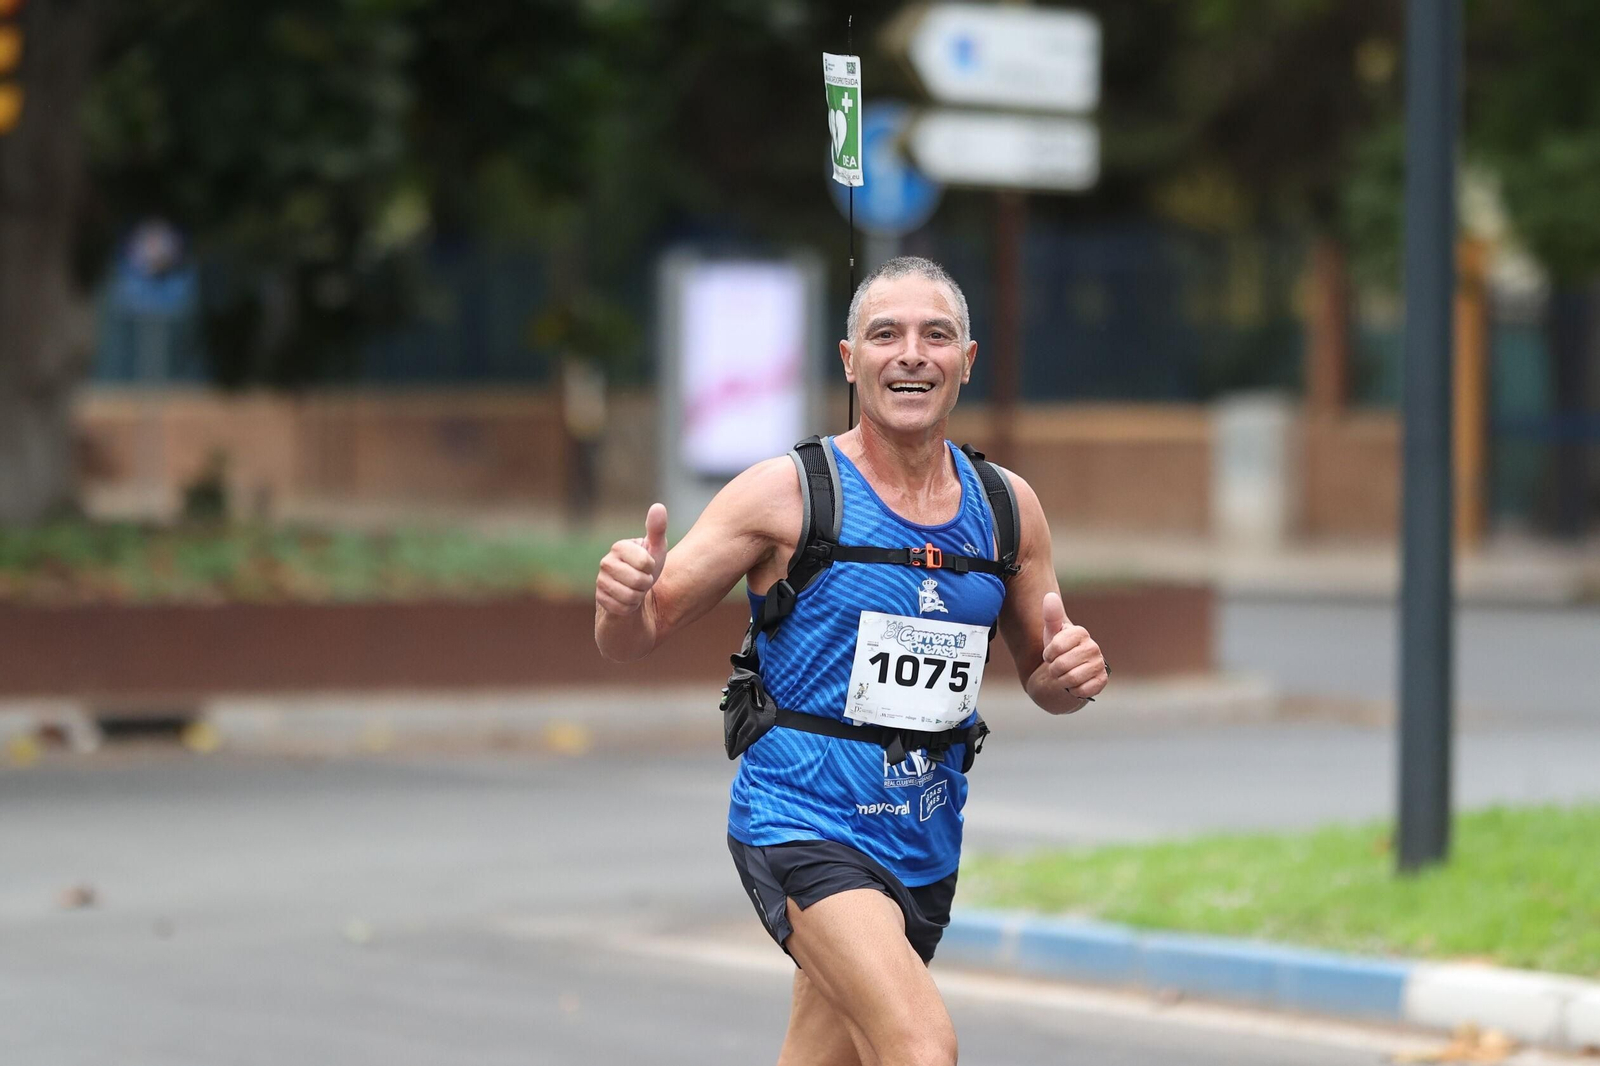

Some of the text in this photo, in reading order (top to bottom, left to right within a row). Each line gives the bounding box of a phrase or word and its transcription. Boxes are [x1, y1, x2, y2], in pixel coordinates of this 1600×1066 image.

[842, 154, 858, 168] DEA
[899, 625, 956, 648] Carrera
[910, 641, 958, 658] Prensa
[868, 651, 971, 693] 1075
[884, 780, 895, 788] REAL
[855, 800, 910, 815] mayoral
